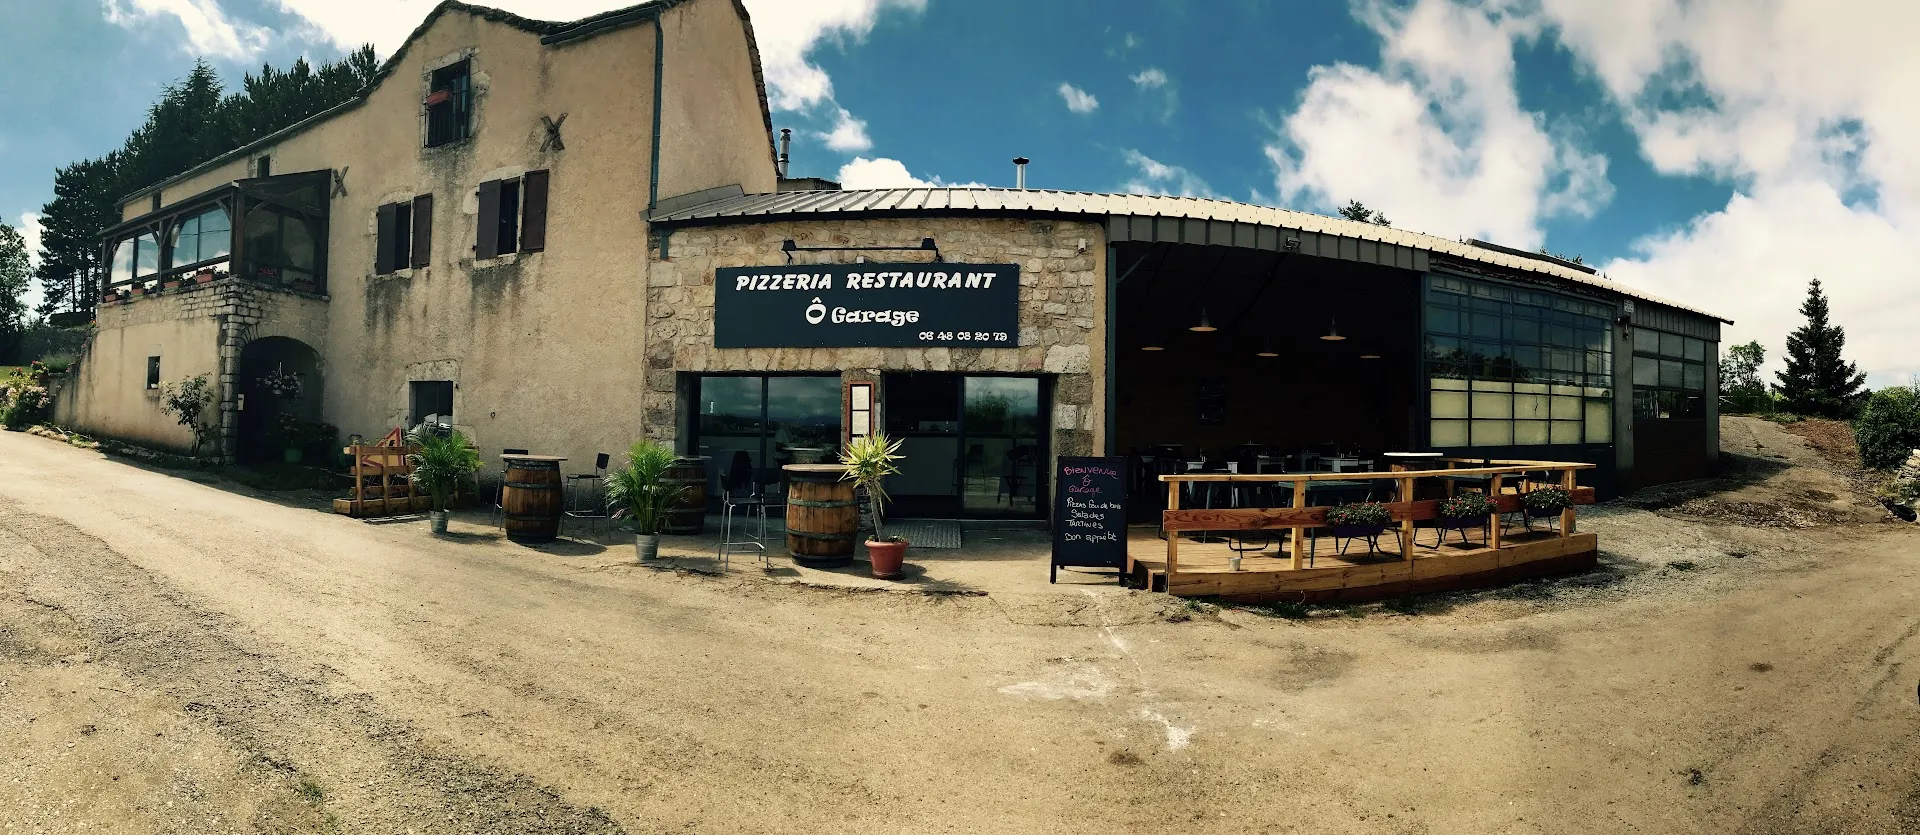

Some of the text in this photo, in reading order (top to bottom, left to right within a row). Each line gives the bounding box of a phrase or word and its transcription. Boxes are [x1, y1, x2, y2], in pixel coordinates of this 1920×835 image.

[735, 272, 996, 291] PIZZERIA RESTAURANT
[805, 297, 920, 327] Ô Garage
[918, 331, 1007, 341] 06 48 08 20 79
[1068, 485, 1103, 498] Garage
